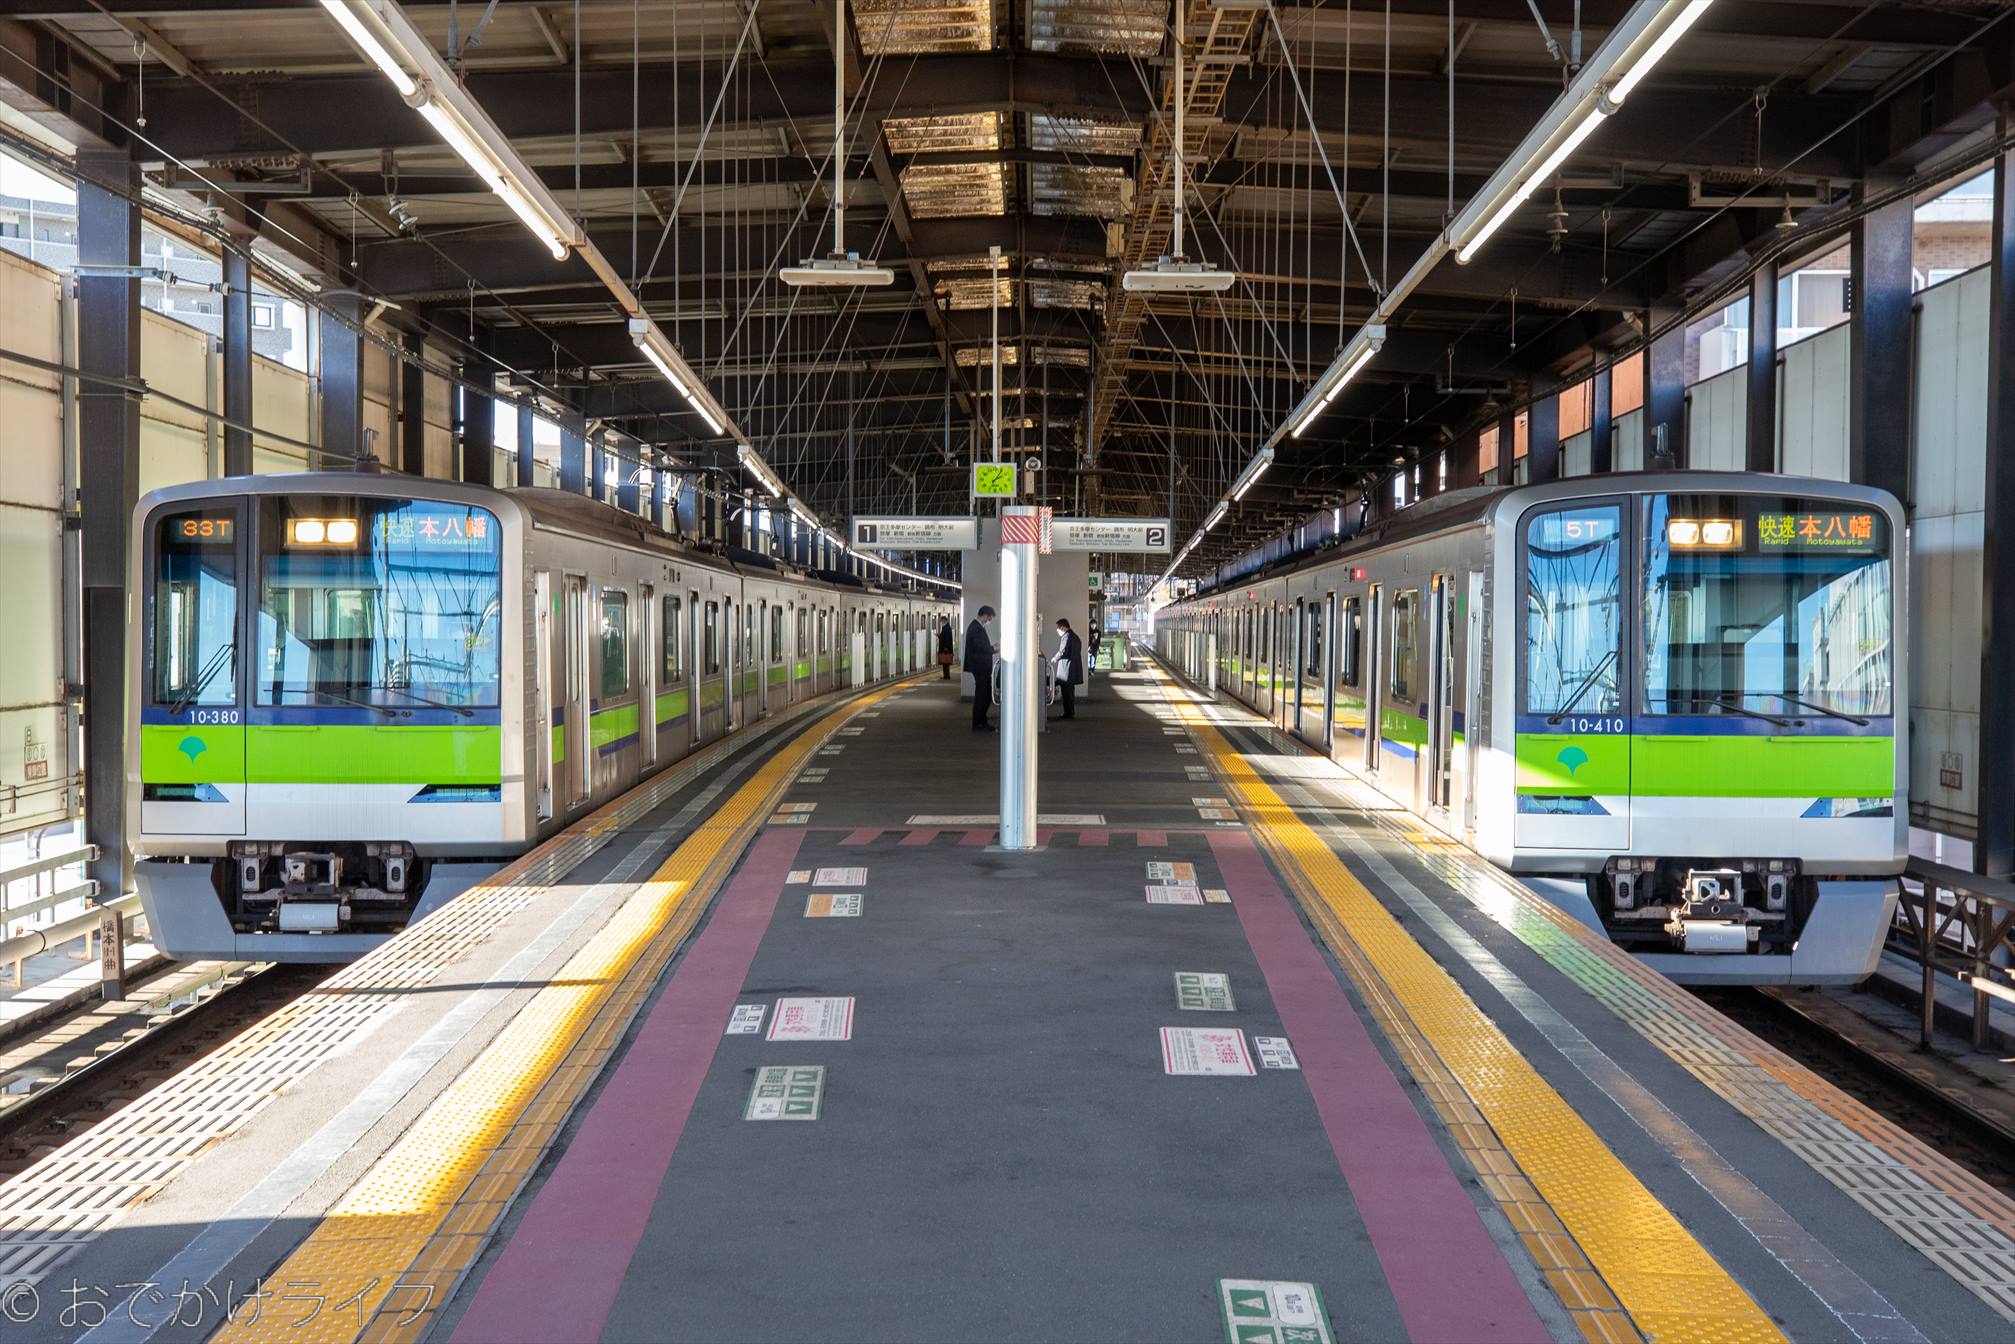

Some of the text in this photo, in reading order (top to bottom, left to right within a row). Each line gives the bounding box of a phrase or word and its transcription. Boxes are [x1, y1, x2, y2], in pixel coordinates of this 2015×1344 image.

[184, 519, 231, 537] 33T
[419, 515, 487, 539] 本八幡
[863, 525, 871, 542] 1
[1567, 520, 1599, 538] 5T
[1758, 514, 1872, 539] 快速 本八幡
[1148, 529, 1163, 545] 2
[189, 710, 239, 724] 10-380
[1570, 717, 1624, 733] 10-410
